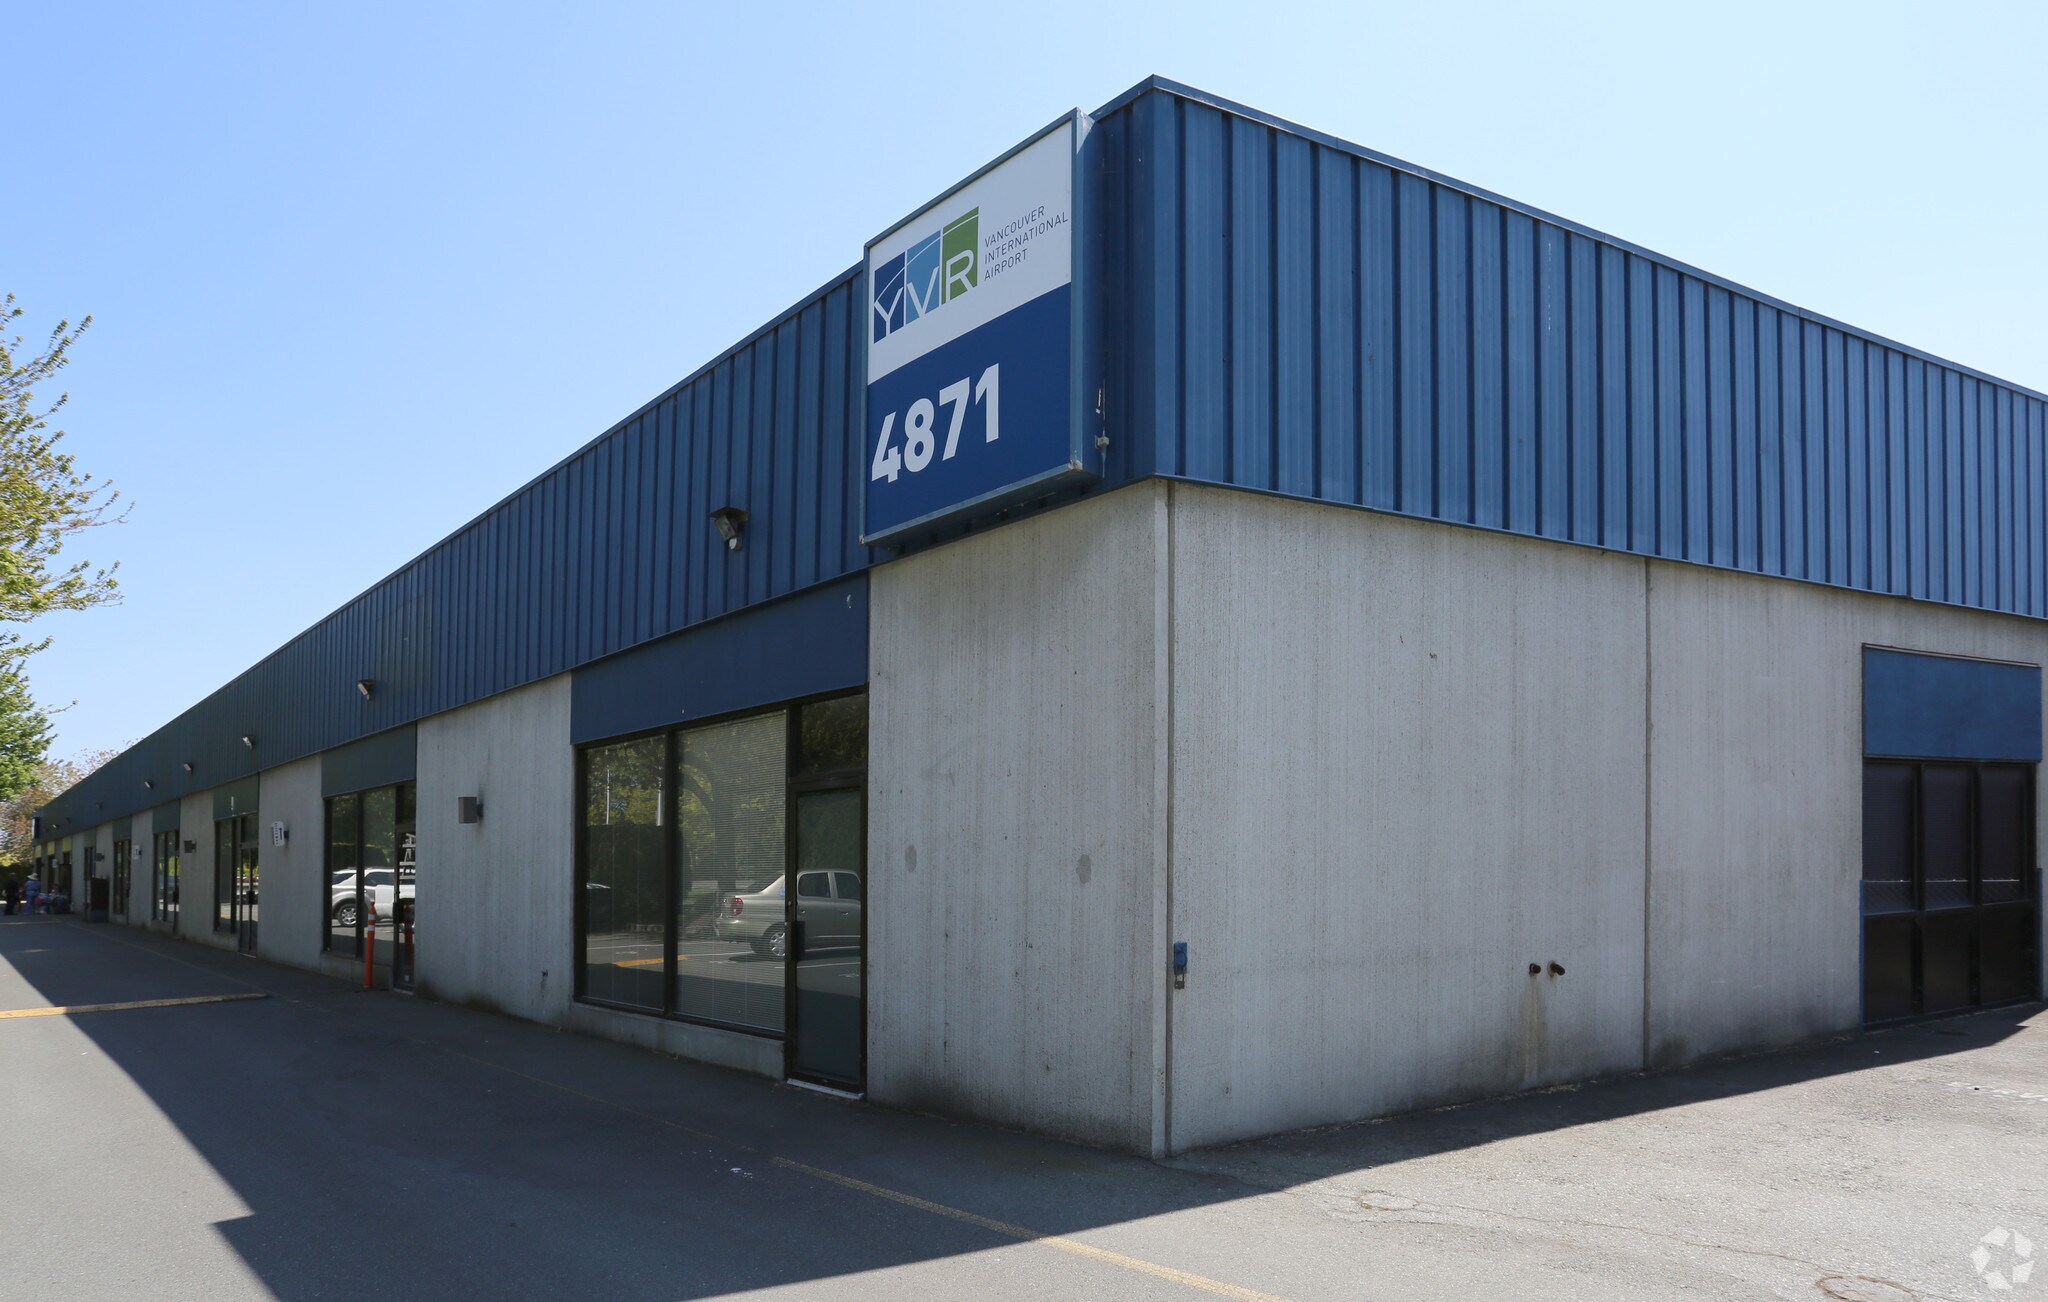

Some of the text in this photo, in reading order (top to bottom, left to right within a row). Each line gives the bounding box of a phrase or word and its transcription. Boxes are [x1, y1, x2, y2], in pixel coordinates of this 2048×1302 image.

[984, 205, 1045, 248] VANCOUVER
[984, 212, 1069, 265] INTERNATIONAL
[984, 248, 1028, 281] AIRPORT
[874, 248, 977, 337] YVR
[871, 363, 1000, 483] 4871
